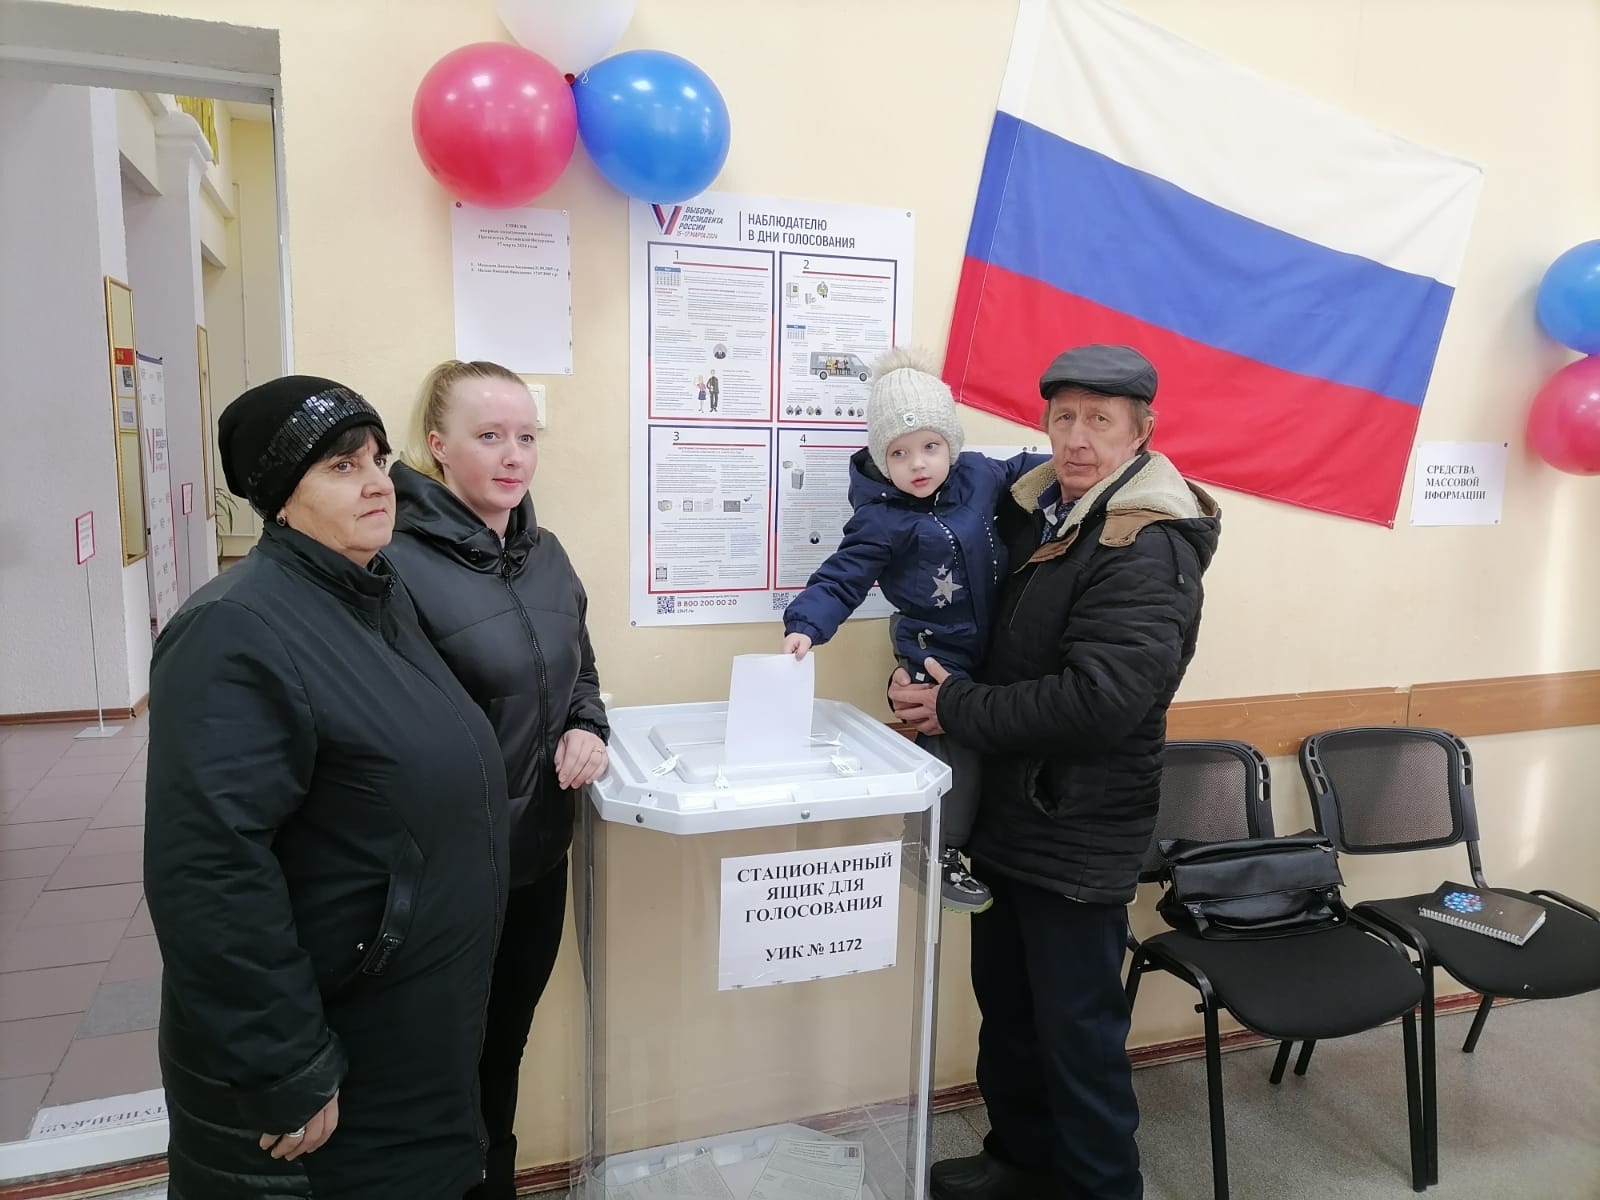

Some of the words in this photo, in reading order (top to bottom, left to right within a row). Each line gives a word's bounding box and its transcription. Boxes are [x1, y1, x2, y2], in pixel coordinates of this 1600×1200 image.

[685, 206, 715, 215] ВЫБОРЫ
[681, 214, 724, 224] ПРЕЗИДЕНТА
[748, 213, 828, 231] НАБЛЮДАТЕЛЮ
[678, 222, 706, 231] РОССИИ
[748, 229, 755, 241] В
[757, 230, 780, 243] ДНИ
[782, 232, 856, 249] ГОЛОСОВАНИЯ
[674, 250, 679, 260] 1
[803, 259, 810, 269] 2
[672, 431, 680, 441] 3
[799, 433, 807, 444] 4
[1426, 464, 1475, 475] СРЕДСТВА
[1425, 477, 1480, 487] МАССОВОЙ
[1424, 490, 1487, 501] ИФОРМАЦИИ
[700, 599, 715, 607] 200
[737, 851, 893, 883] СТАЦИОНАРНЫЙ
[766, 882, 825, 901] ЯЩИК
[828, 878, 865, 896] ДЛЯ
[745, 895, 883, 923] ГОЛОСОВАНИЯ
[765, 944, 804, 962] УИК
[807, 942, 825, 957] №
[829, 938, 863, 954] 1172
